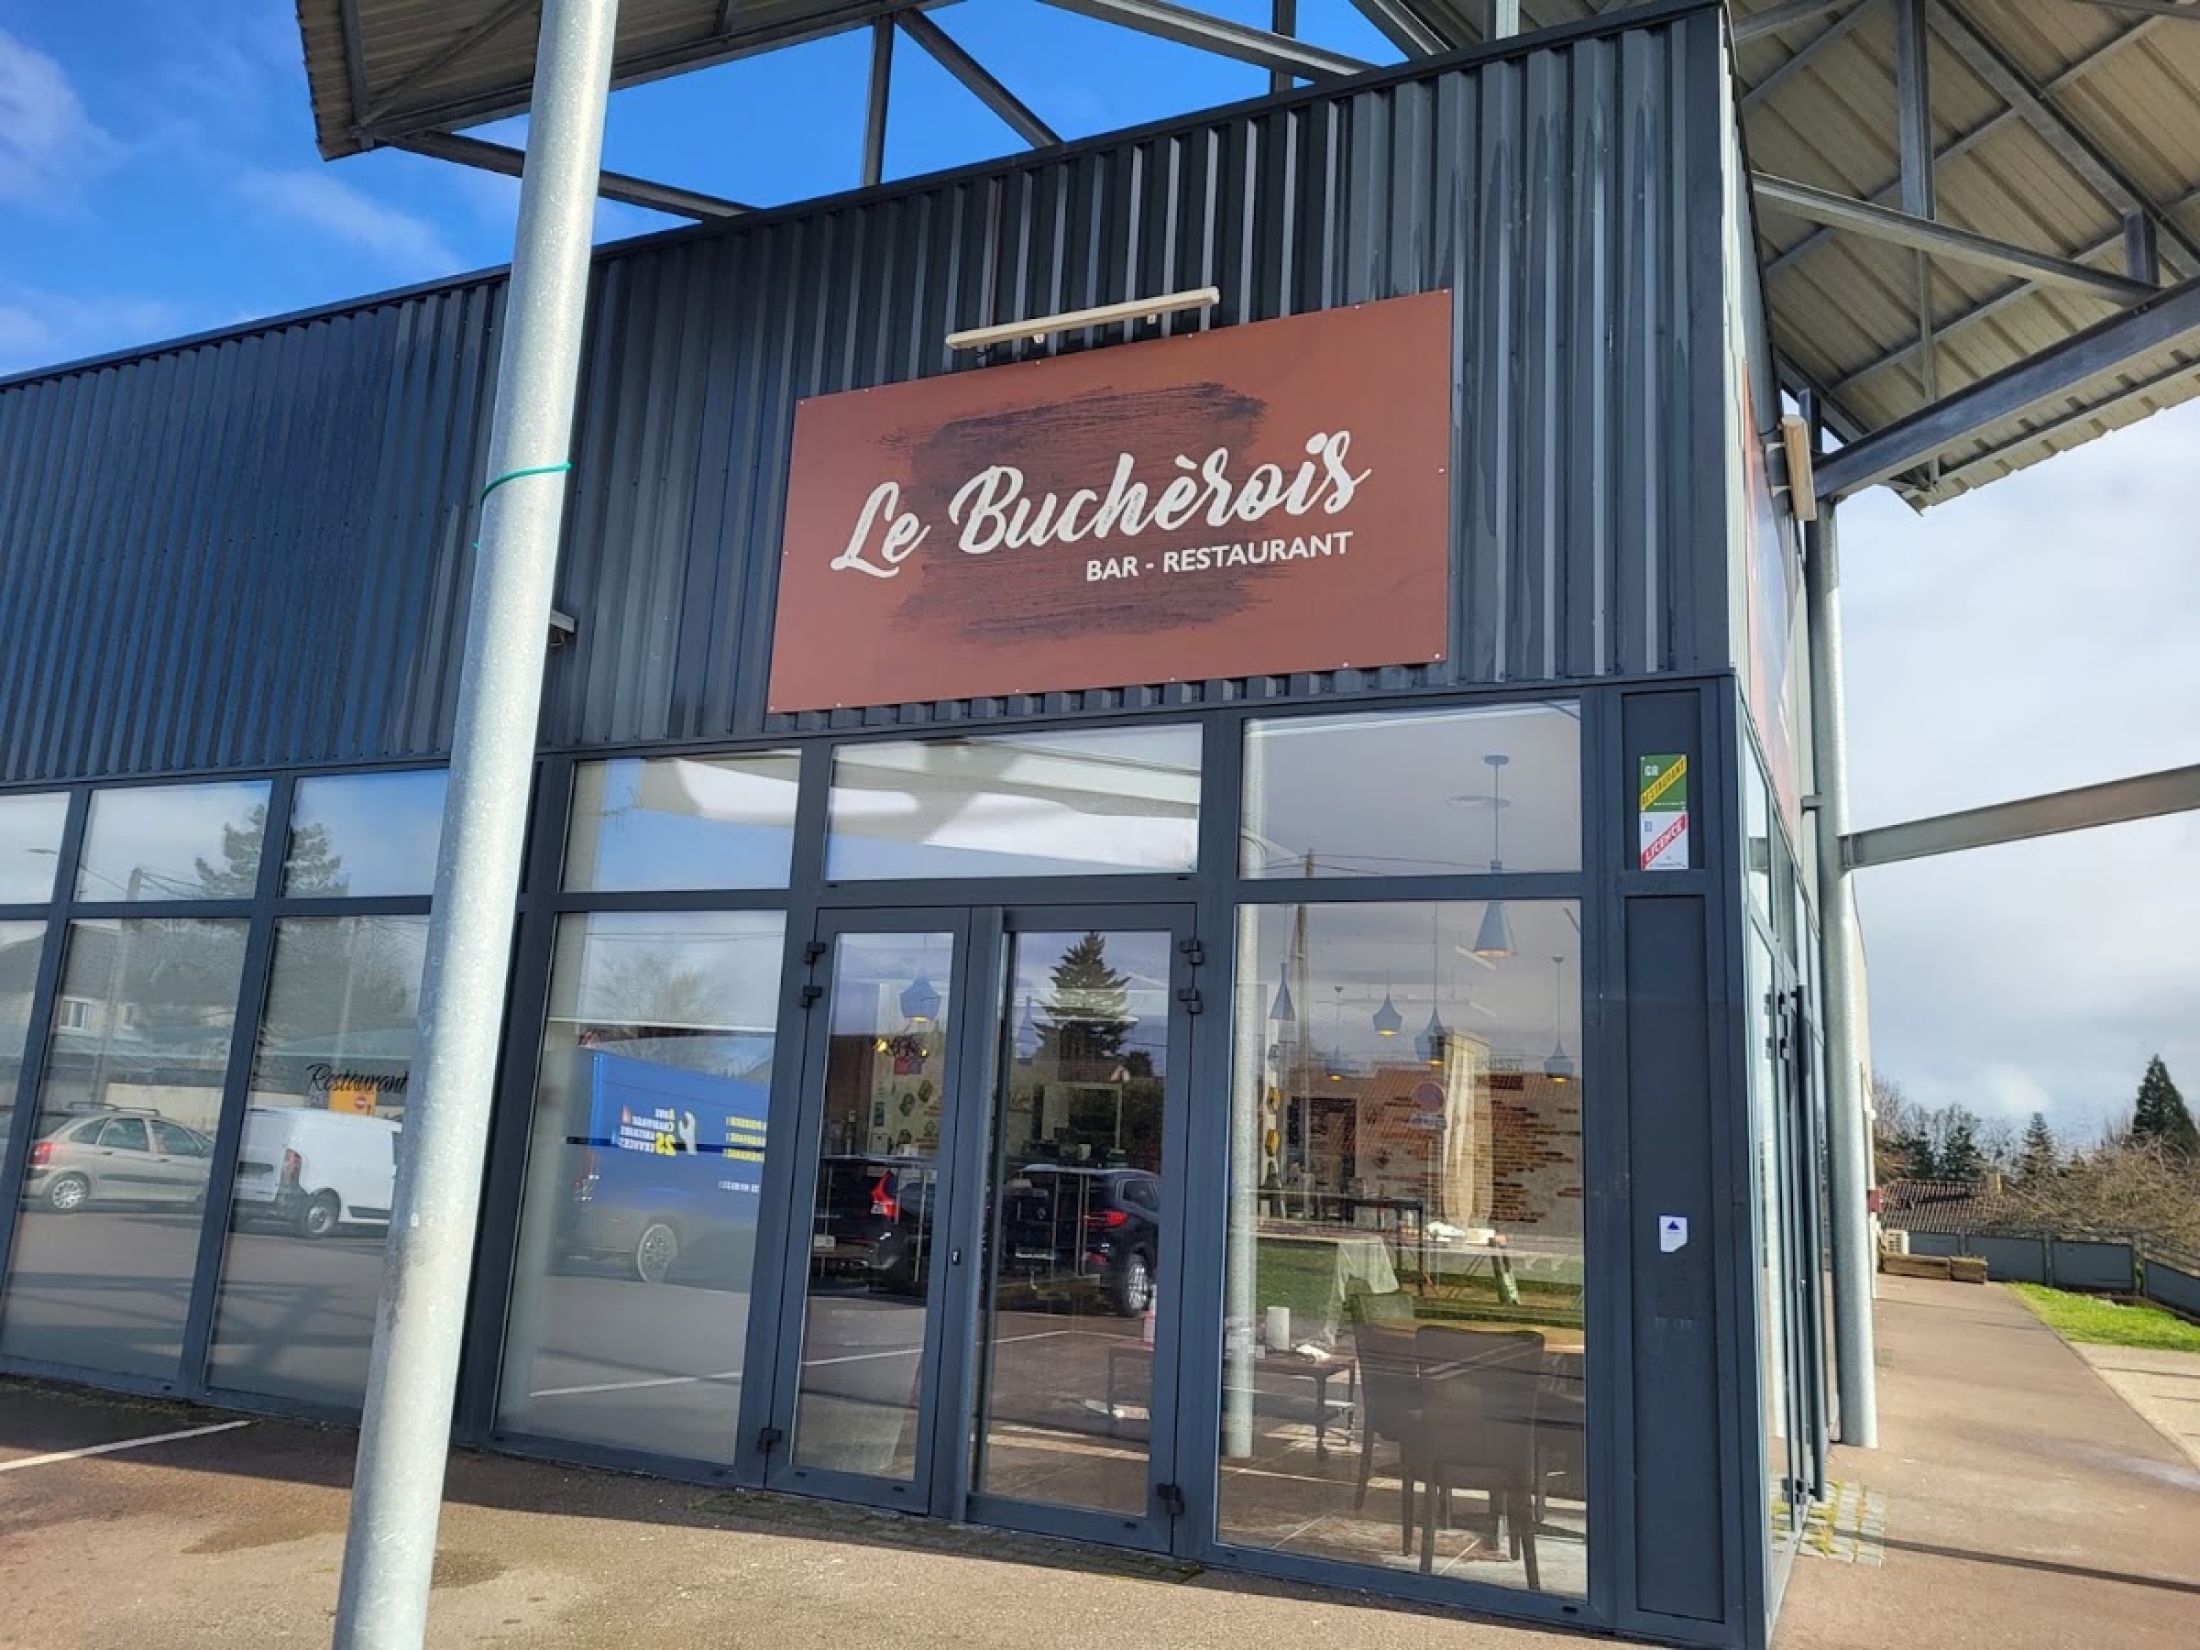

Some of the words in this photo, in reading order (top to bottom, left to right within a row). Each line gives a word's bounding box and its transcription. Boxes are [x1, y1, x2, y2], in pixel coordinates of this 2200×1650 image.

[829, 481, 931, 579] Le
[948, 430, 1373, 556] Buchèrois
[1086, 556, 1139, 582] BAR
[1163, 530, 1354, 573] RESTAURANT
